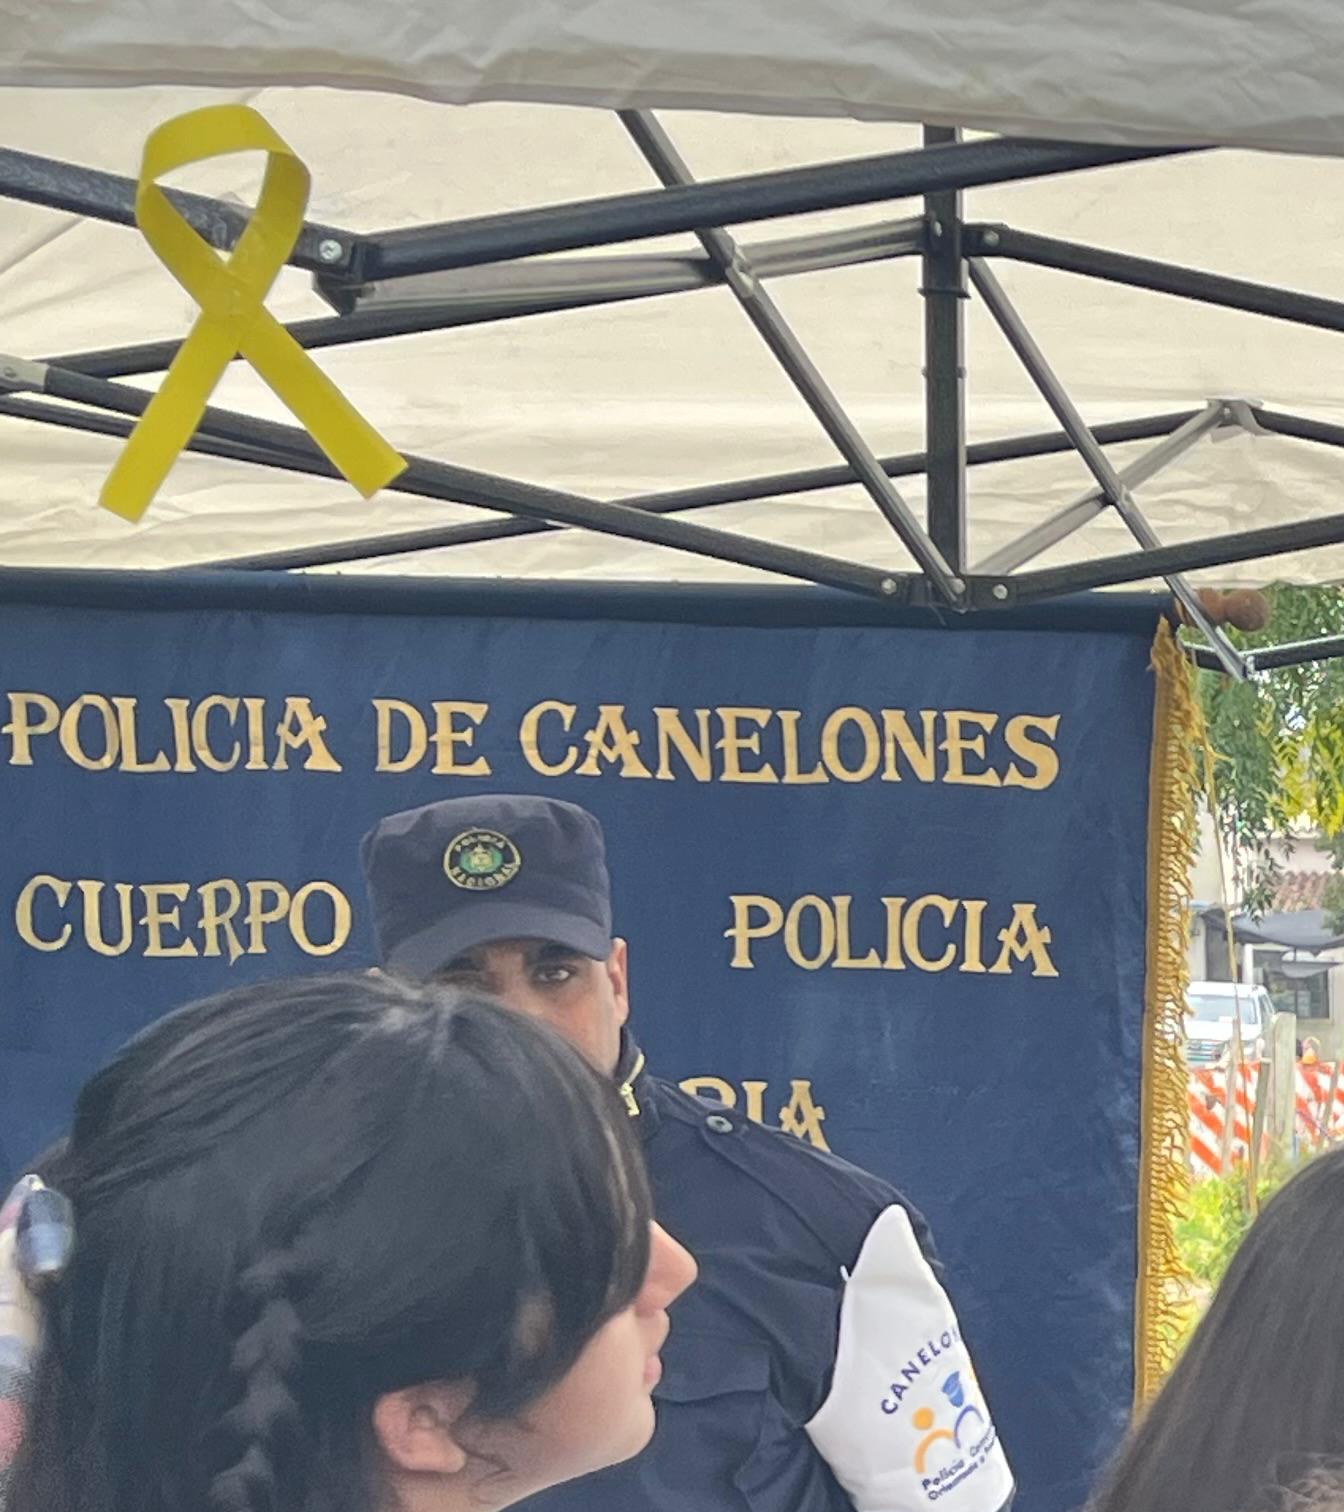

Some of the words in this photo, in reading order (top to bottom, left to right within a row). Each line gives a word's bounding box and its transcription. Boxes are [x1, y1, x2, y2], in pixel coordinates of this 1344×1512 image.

[2, 692, 342, 773] POLICIA
[373, 698, 491, 777] DE
[518, 699, 1061, 791] CANELONES
[15, 874, 352, 961] CUERPO
[726, 893, 1058, 978] POLICIA
